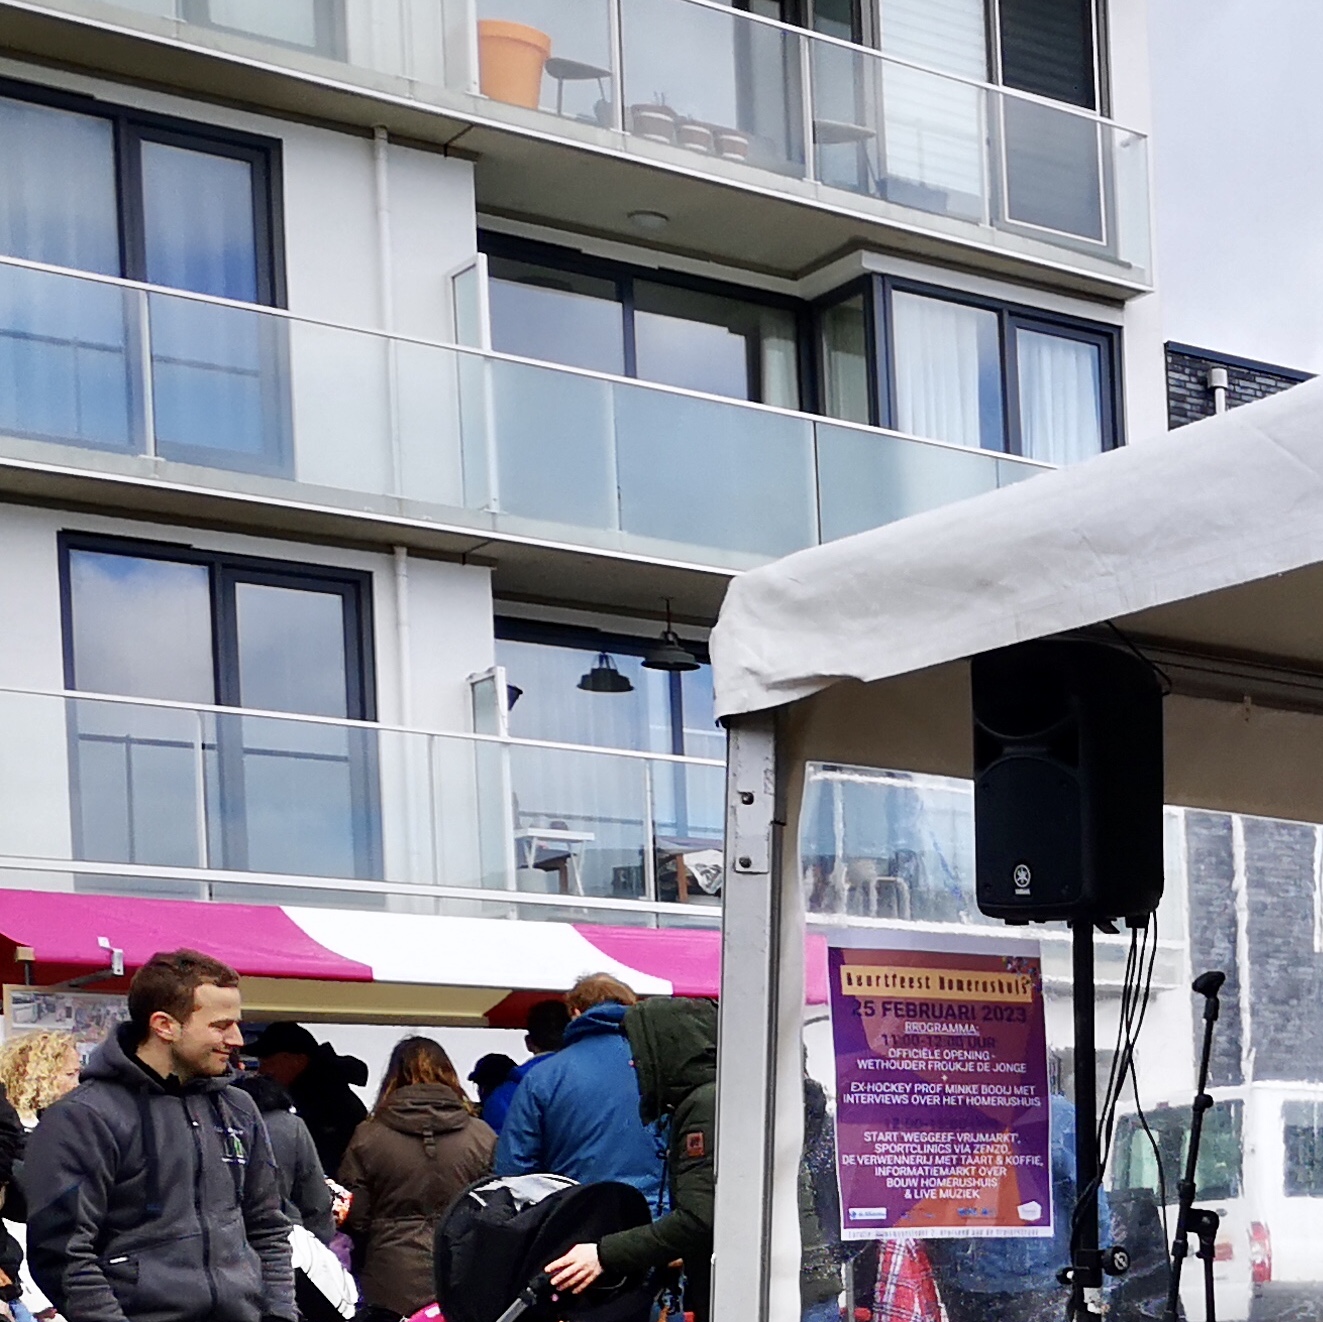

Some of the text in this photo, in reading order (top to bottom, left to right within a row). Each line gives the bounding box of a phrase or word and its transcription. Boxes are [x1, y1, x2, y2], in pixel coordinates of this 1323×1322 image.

[852, 1000, 1026, 1023] 25 FEBRUARI 2023
[943, 1049, 990, 1060] OPENING
[857, 1059, 1027, 1073] WETHOUDER FROUKJE DE JONGE
[850, 1082, 1035, 1096] EX-HOCKEY PROF MINKE BOOIJ MET
[843, 1093, 1042, 1107] INTERVIEWS OVER HET HOMERUSHUIS
[864, 1131, 899, 1142] START
[874, 1143, 951, 1154] SPORTCLINICS
[953, 1144, 971, 1154] VIA
[842, 1155, 856, 1165] DE
[857, 1155, 934, 1165] VERWENNERIJ
[935, 1155, 958, 1165] MET
[961, 1155, 994, 1165] TAART
[875, 1166, 1008, 1177] INFORMATIEMARKT OVER
[886, 1178, 998, 1188] BOUW HOMERUSHUIS
[904, 1189, 981, 1199] & LIVE MUZIEK
